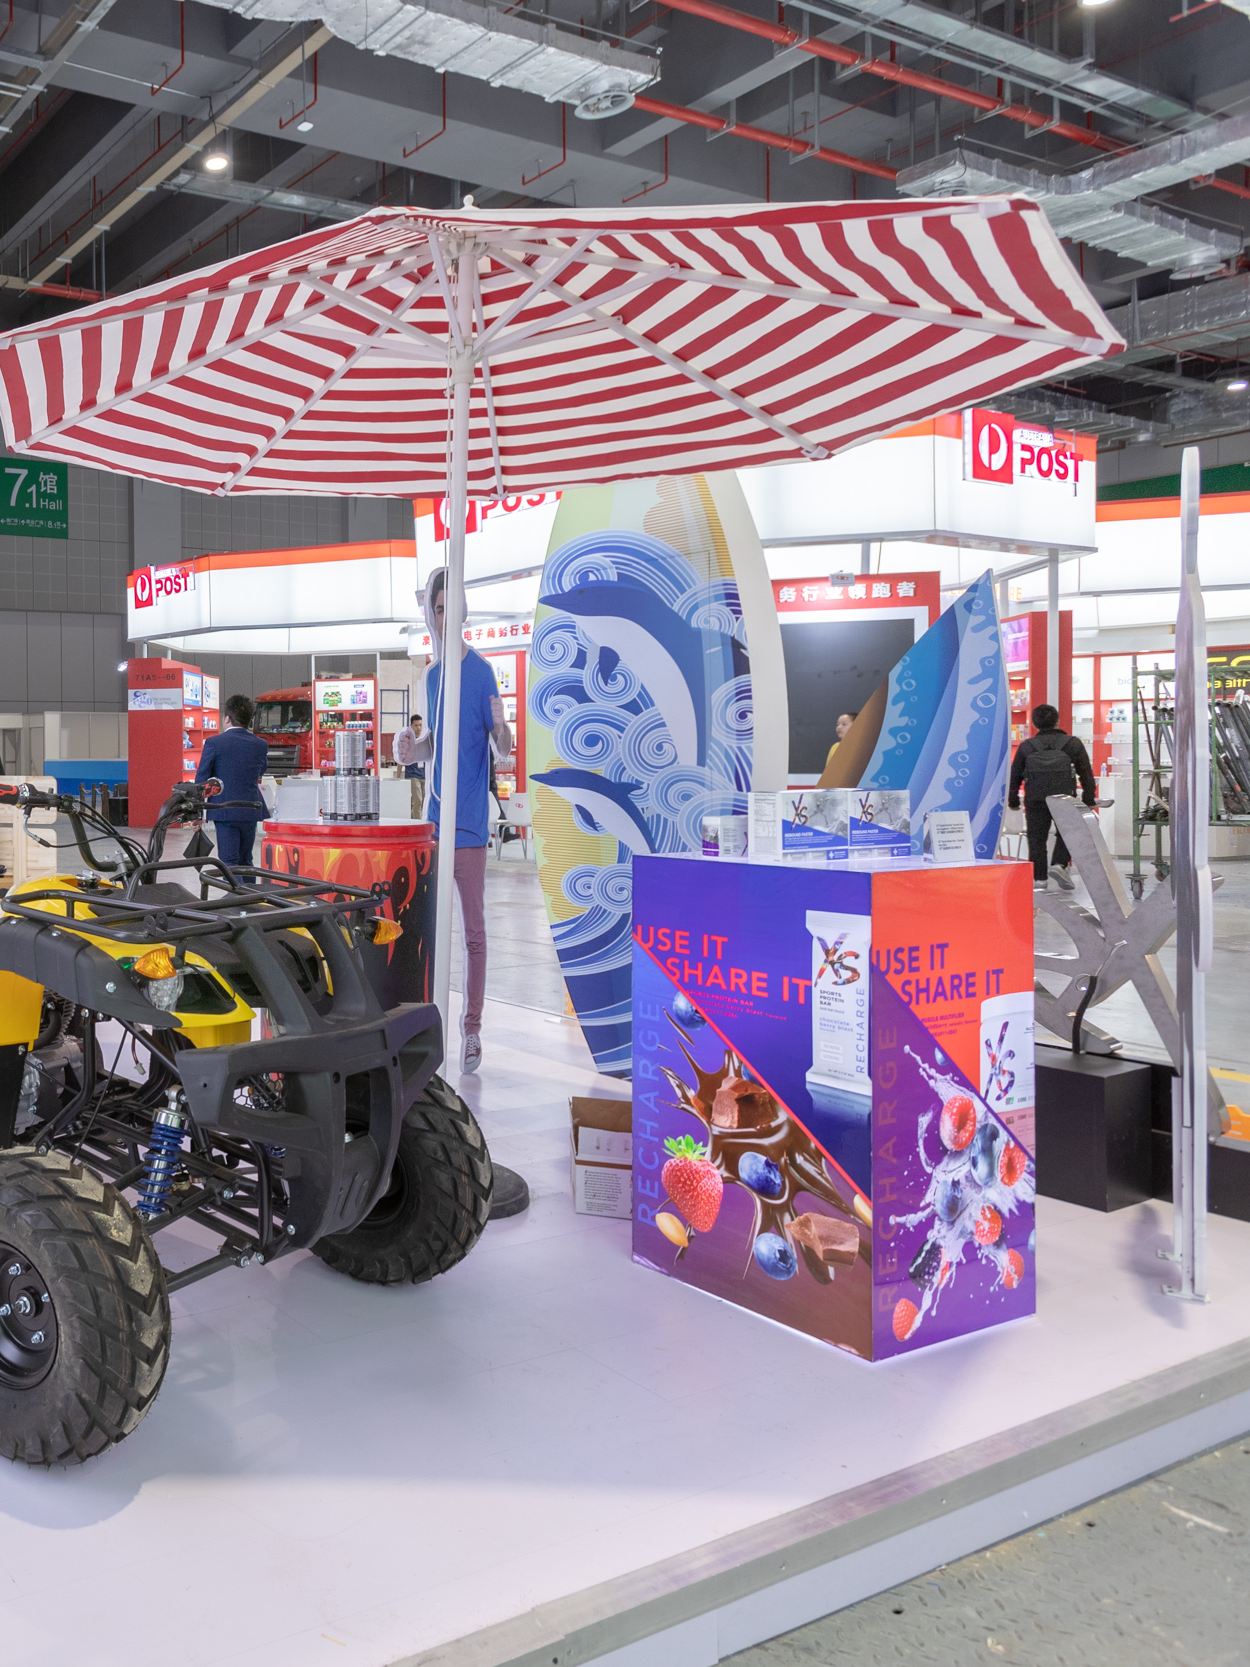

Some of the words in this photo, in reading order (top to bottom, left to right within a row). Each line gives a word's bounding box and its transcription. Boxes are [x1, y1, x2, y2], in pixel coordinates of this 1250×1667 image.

[1020, 443, 1084, 482] POST
[4, 467, 37, 508] 7.1
[38, 471, 58, 494] 馆
[40, 498, 63, 510] Hall
[155, 571, 189, 598] POST
[779, 581, 916, 603] 务行业领跑者
[637, 924, 690, 955] USE
[702, 934, 729, 960] IT
[876, 946, 920, 977] USE
[930, 942, 949, 971] IT
[666, 957, 769, 998] SHARE
[782, 976, 812, 1005] IT
[901, 971, 977, 1007] SHARE
[985, 968, 1004, 996] IT
[711, 994, 738, 1004] PROTEIN
[819, 990, 842, 998] SPORTS
[819, 995, 845, 1004] PROTEIN
[726, 1004, 744, 1012] berry
[746, 1008, 763, 1016] blast
[819, 1017, 850, 1027] chocolate
[939, 1012, 964, 1020] MULTIPLIER
[838, 1025, 854, 1033] blast
[855, 987, 865, 1074] RECHARGE
[637, 1000, 660, 1228] RECHARGE
[878, 1025, 898, 1313] RECHARGE
